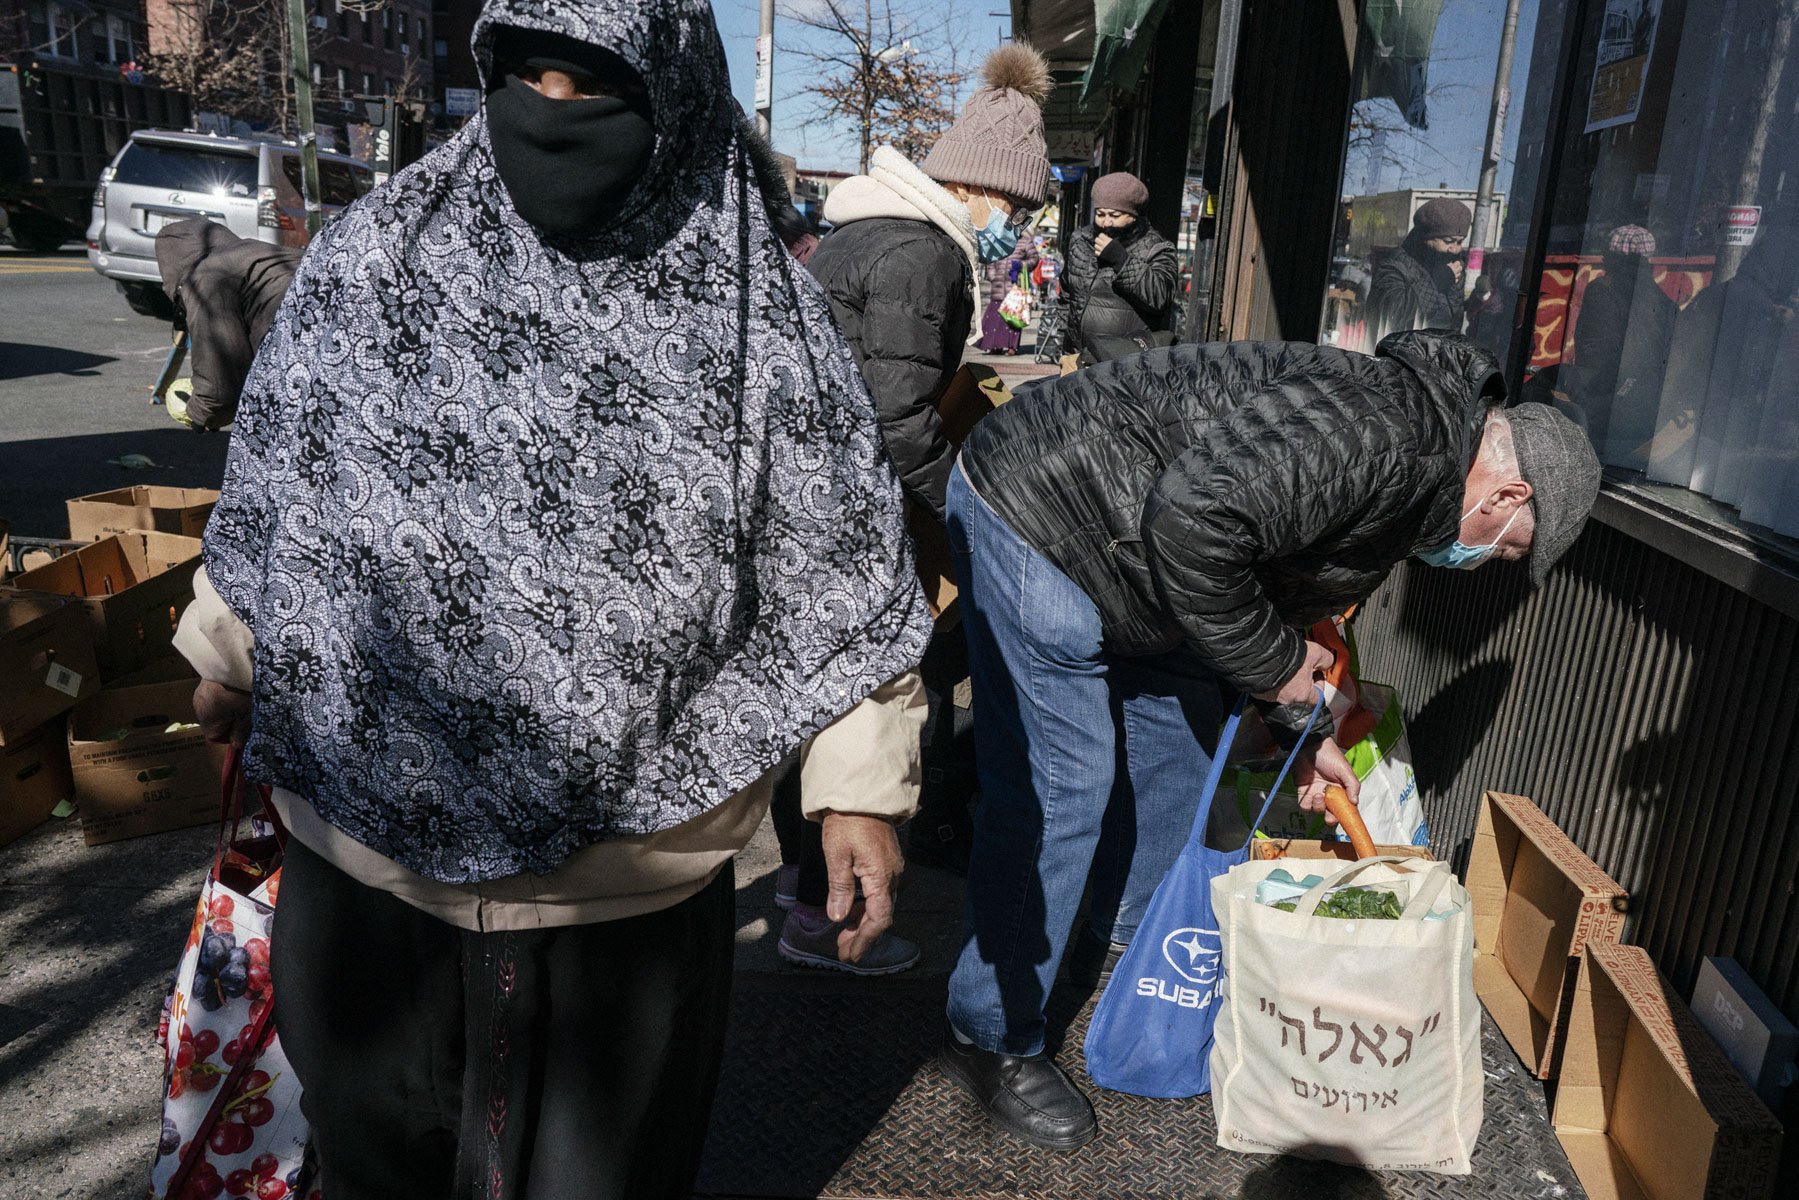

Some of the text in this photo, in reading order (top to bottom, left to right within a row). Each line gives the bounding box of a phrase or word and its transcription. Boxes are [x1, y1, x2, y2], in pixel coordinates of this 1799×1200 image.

[375, 129, 390, 162] Yale
[1572, 914, 1591, 956] LIPMA
[1604, 912, 1620, 943] ELVE
[1137, 977, 1224, 1009] SUBA
